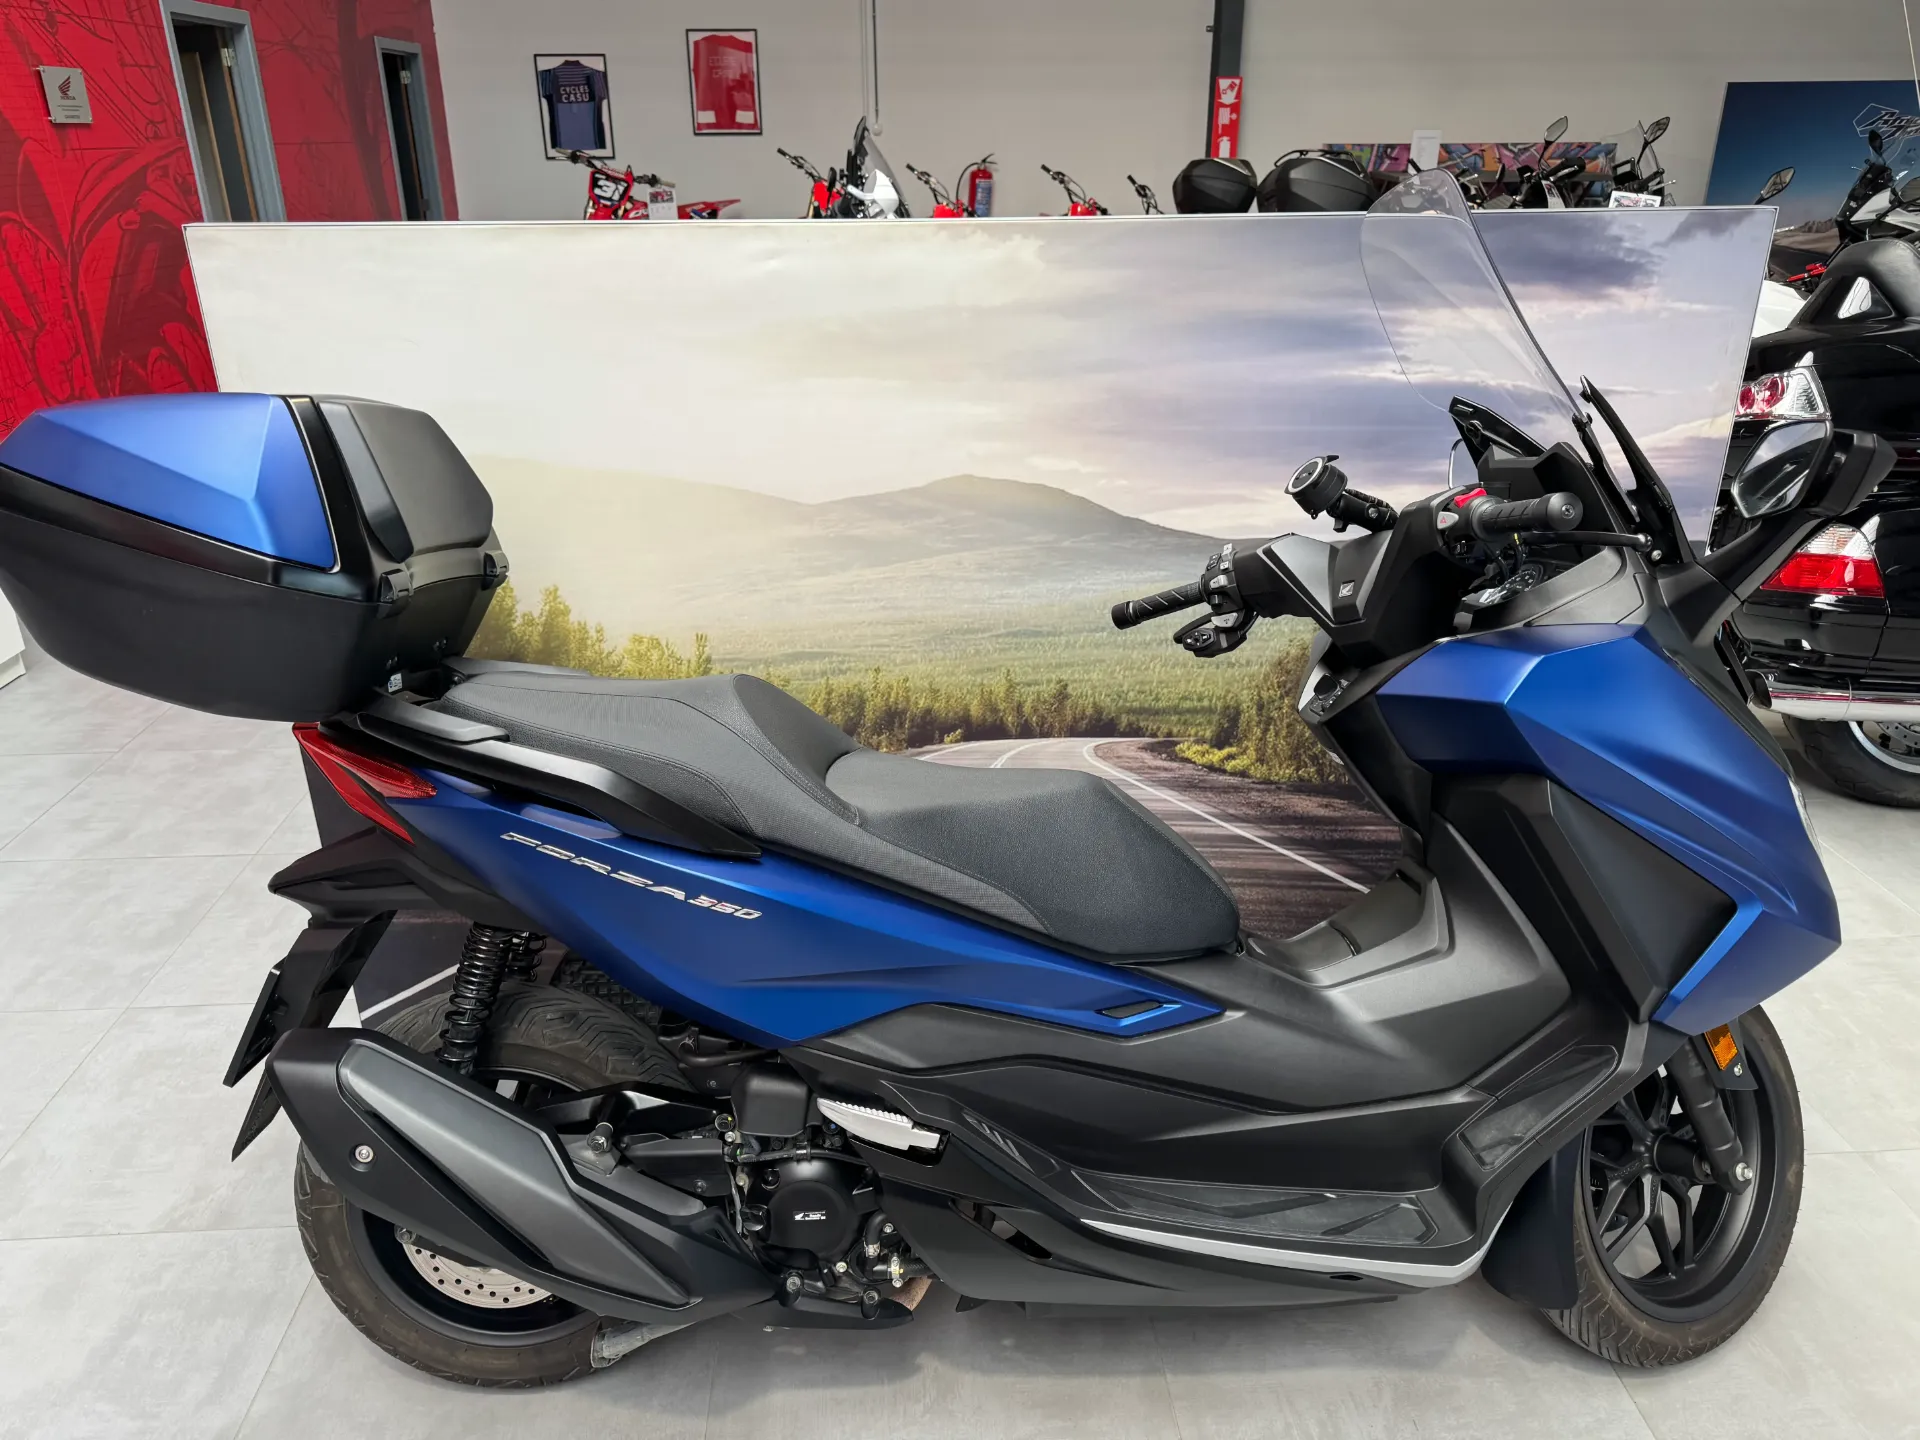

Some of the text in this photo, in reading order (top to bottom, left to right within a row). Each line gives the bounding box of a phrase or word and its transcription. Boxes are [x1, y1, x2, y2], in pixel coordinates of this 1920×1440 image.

[560, 85, 590, 94] CYCLES
[562, 93, 590, 102] CASU
[499, 831, 763, 920] FORZA 350
